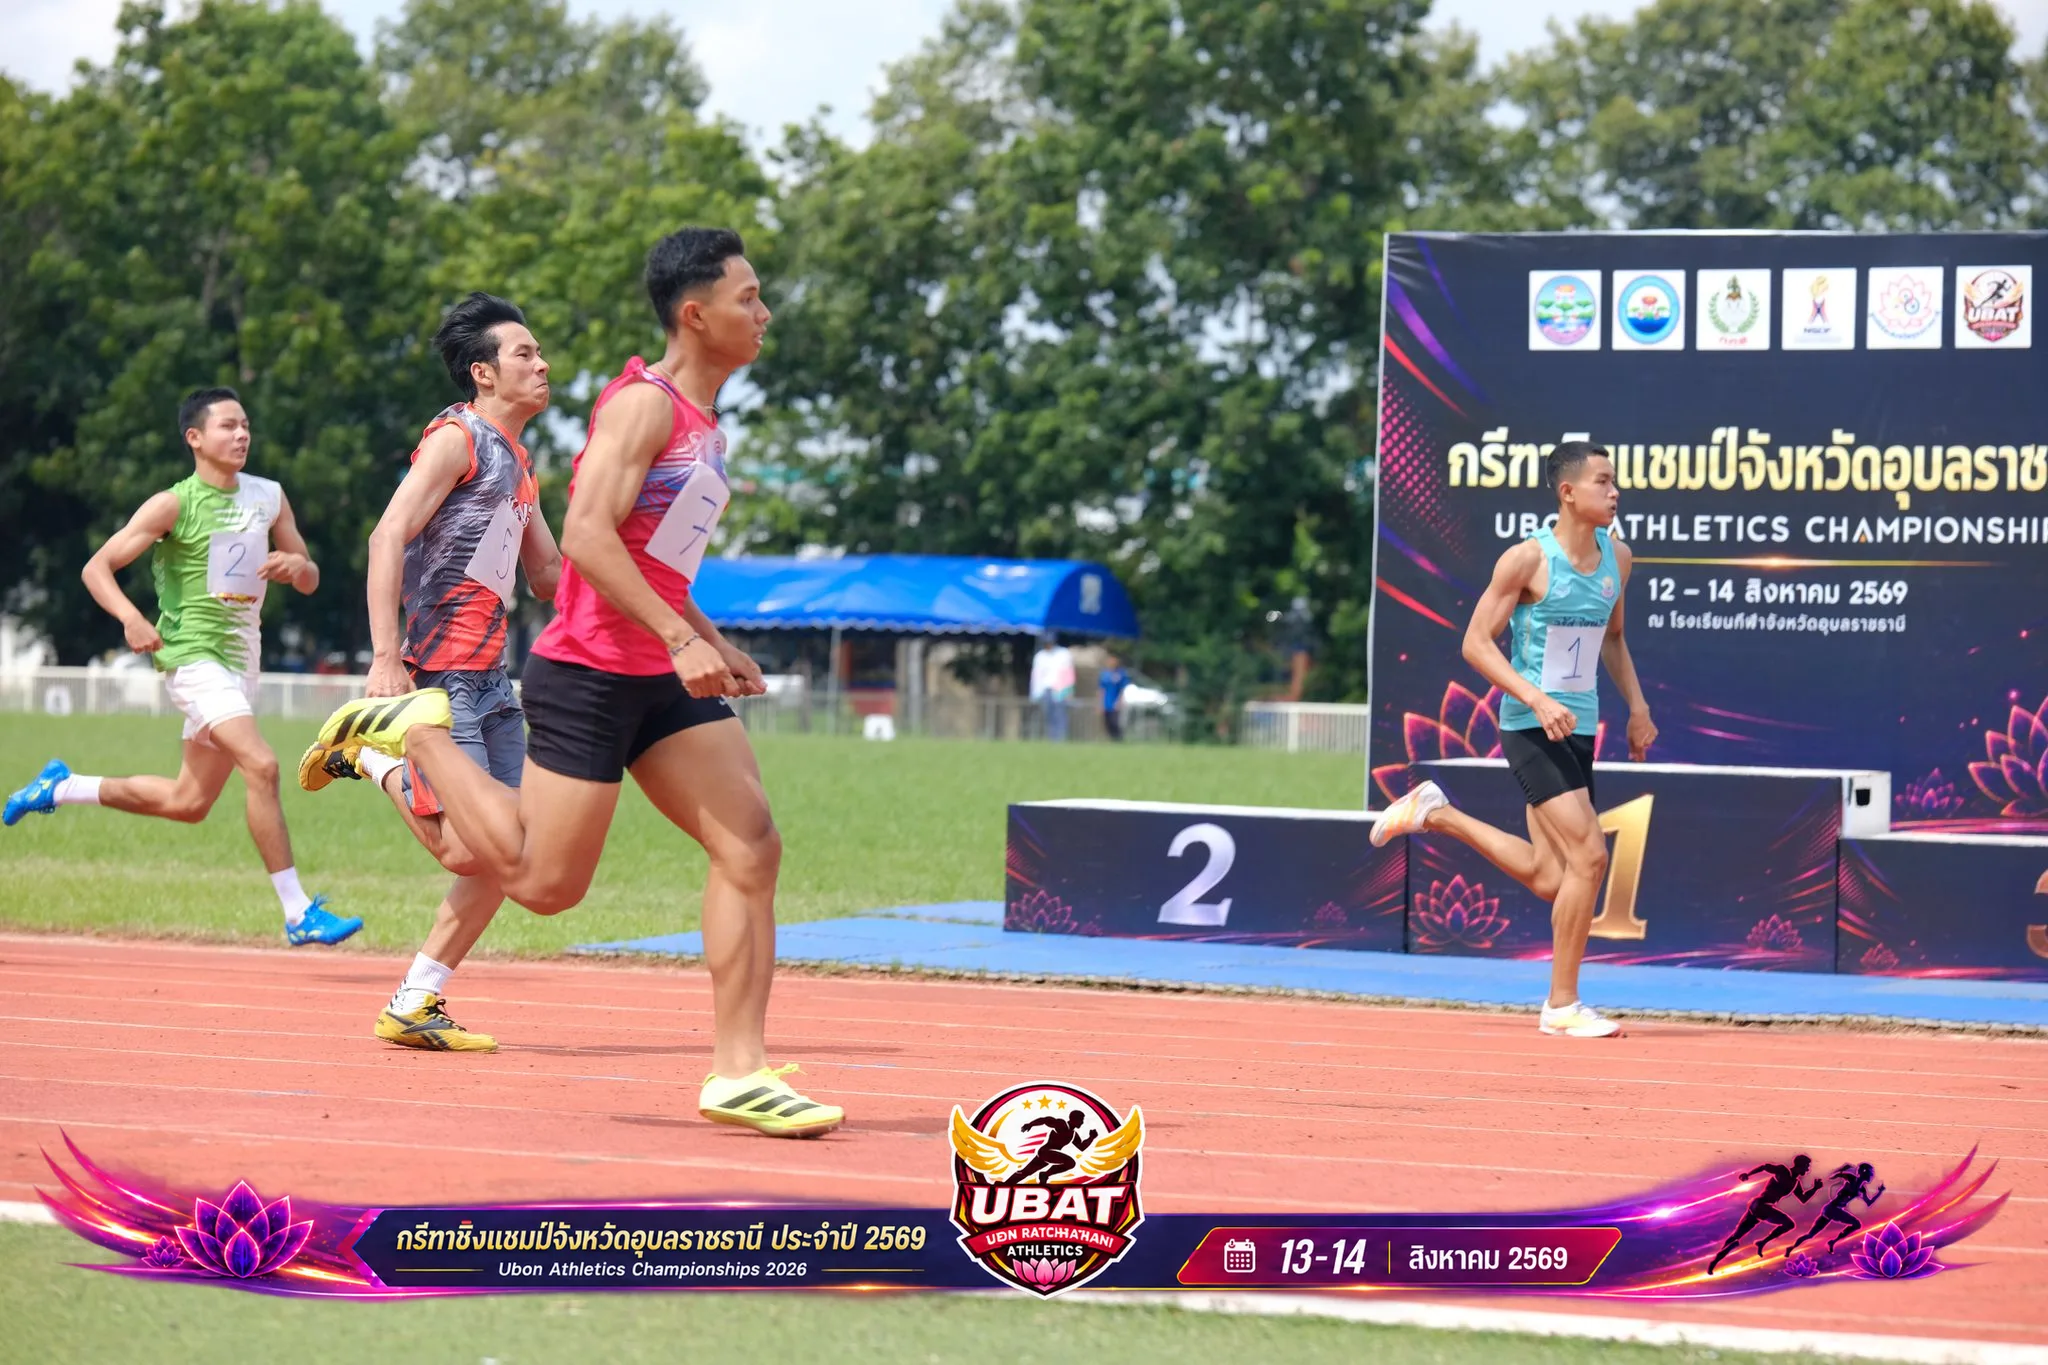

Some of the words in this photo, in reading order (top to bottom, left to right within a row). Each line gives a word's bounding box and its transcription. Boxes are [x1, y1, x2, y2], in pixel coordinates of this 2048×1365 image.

[1968, 306, 2019, 323] UBAT
[679, 495, 717, 556] 7
[1607, 514, 1790, 543] ATHLETICS
[1805, 515, 2048, 544] CHAMPIONSHI
[224, 542, 246, 577] 2
[1648, 578, 1675, 601] 12
[1708, 579, 1735, 602] 14
[1745, 578, 1840, 604] สิงหาคม
[1849, 580, 1909, 605] 2569
[1562, 637, 1582, 680] 1
[1157, 823, 1236, 928] 2
[1589, 794, 1654, 940] 1
